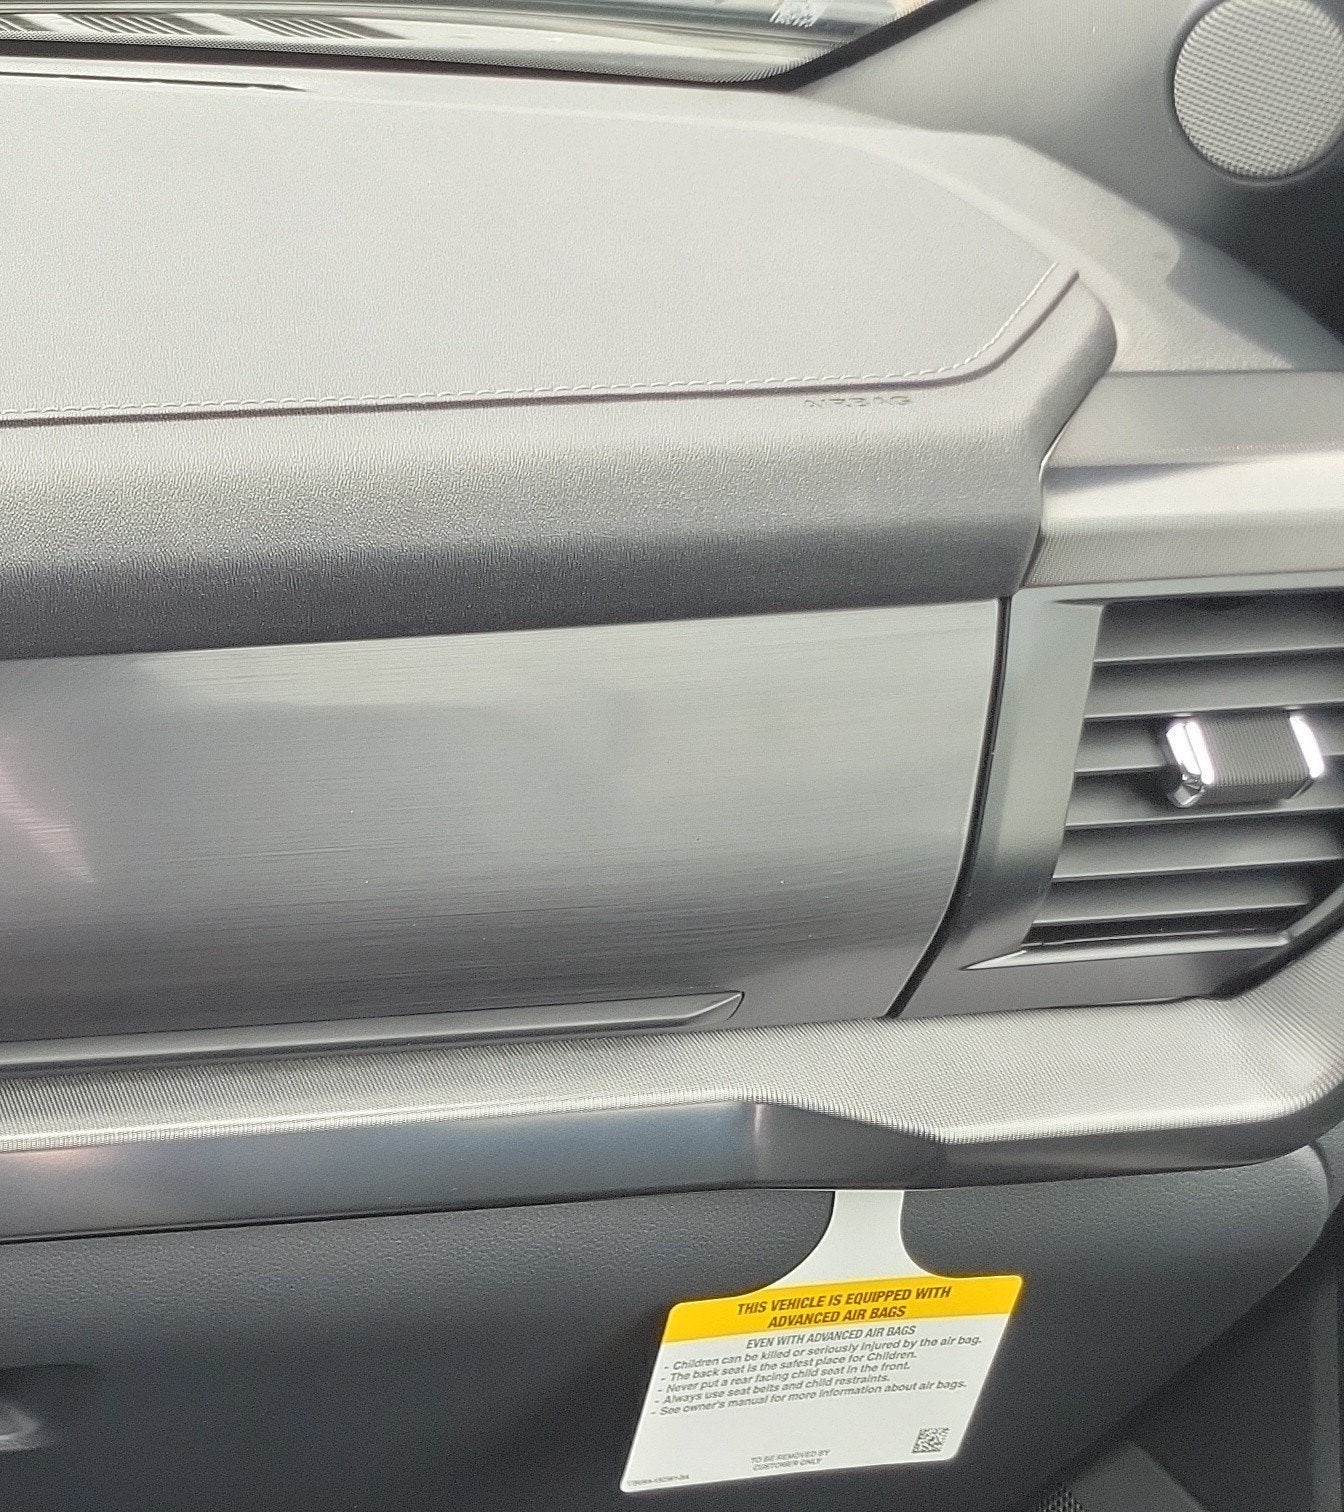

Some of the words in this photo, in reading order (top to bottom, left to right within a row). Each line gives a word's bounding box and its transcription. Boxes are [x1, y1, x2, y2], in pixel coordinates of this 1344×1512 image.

[736, 1300, 767, 1316] THIS
[770, 1295, 826, 1312] VEHICLE
[827, 1293, 842, 1307] IS
[845, 1288, 912, 1305] EQUIPPED
[915, 1286, 952, 1300] WITH
[767, 1311, 840, 1329] ADVANCED
[842, 1308, 868, 1322] AIR
[869, 1305, 907, 1320] BAGS
[673, 1356, 719, 1371] Children
[721, 1356, 742, 1366] can
[744, 1352, 758, 1363] be
[761, 1347, 790, 1360] killed
[792, 1348, 804, 1358] or
[806, 1342, 859, 1356] seriously
[860, 1341, 900, 1352] injured
[902, 1339, 917, 1352] by
[920, 1337, 938, 1347] the
[940, 1336, 957, 1346] air
[958, 1335, 982, 1346] bag.
[746, 1336, 774, 1350] EVEN
[776, 1334, 806, 1347] WITH
[806, 1329, 863, 1344] ADVANCED
[865, 1327, 884, 1339] AIR
[886, 1325, 917, 1338] BAGS
[665, 1382, 699, 1395] Never
[699, 1379, 719, 1392] put
[730, 1375, 753, 1387] rear
[754, 1371, 789, 1385] facing
[790, 1366, 818, 1380] child
[820, 1365, 844, 1376] seat
[846, 1363, 858, 1374] in
[860, 1362, 879, 1374] the
[880, 1361, 910, 1372] front.
[670, 1371, 691, 1382] The
[693, 1367, 720, 1380] back
[722, 1364, 745, 1377] seat
[747, 1363, 758, 1374] is
[760, 1360, 777, 1372] the
[779, 1356, 813, 1370] safest
[814, 1353, 846, 1368] place
[848, 1352, 865, 1363] for
[866, 1350, 918, 1363] Children.
[659, 1405, 681, 1417] See
[682, 1400, 725, 1414] owner's
[727, 1395, 769, 1408] manual
[770, 1392, 787, 1404] for
[788, 1390, 816, 1403] more
[818, 1384, 882, 1399] information
[883, 1380, 917, 1393] about
[918, 1379, 935, 1391] air
[936, 1379, 968, 1391] bags.
[662, 1393, 702, 1406] Always
[704, 1390, 725, 1400] use
[727, 1385, 751, 1398] seat
[753, 1382, 779, 1395] belts
[781, 1379, 803, 1392] and
[805, 1376, 833, 1388] child
[834, 1373, 890, 1387] restraints.
